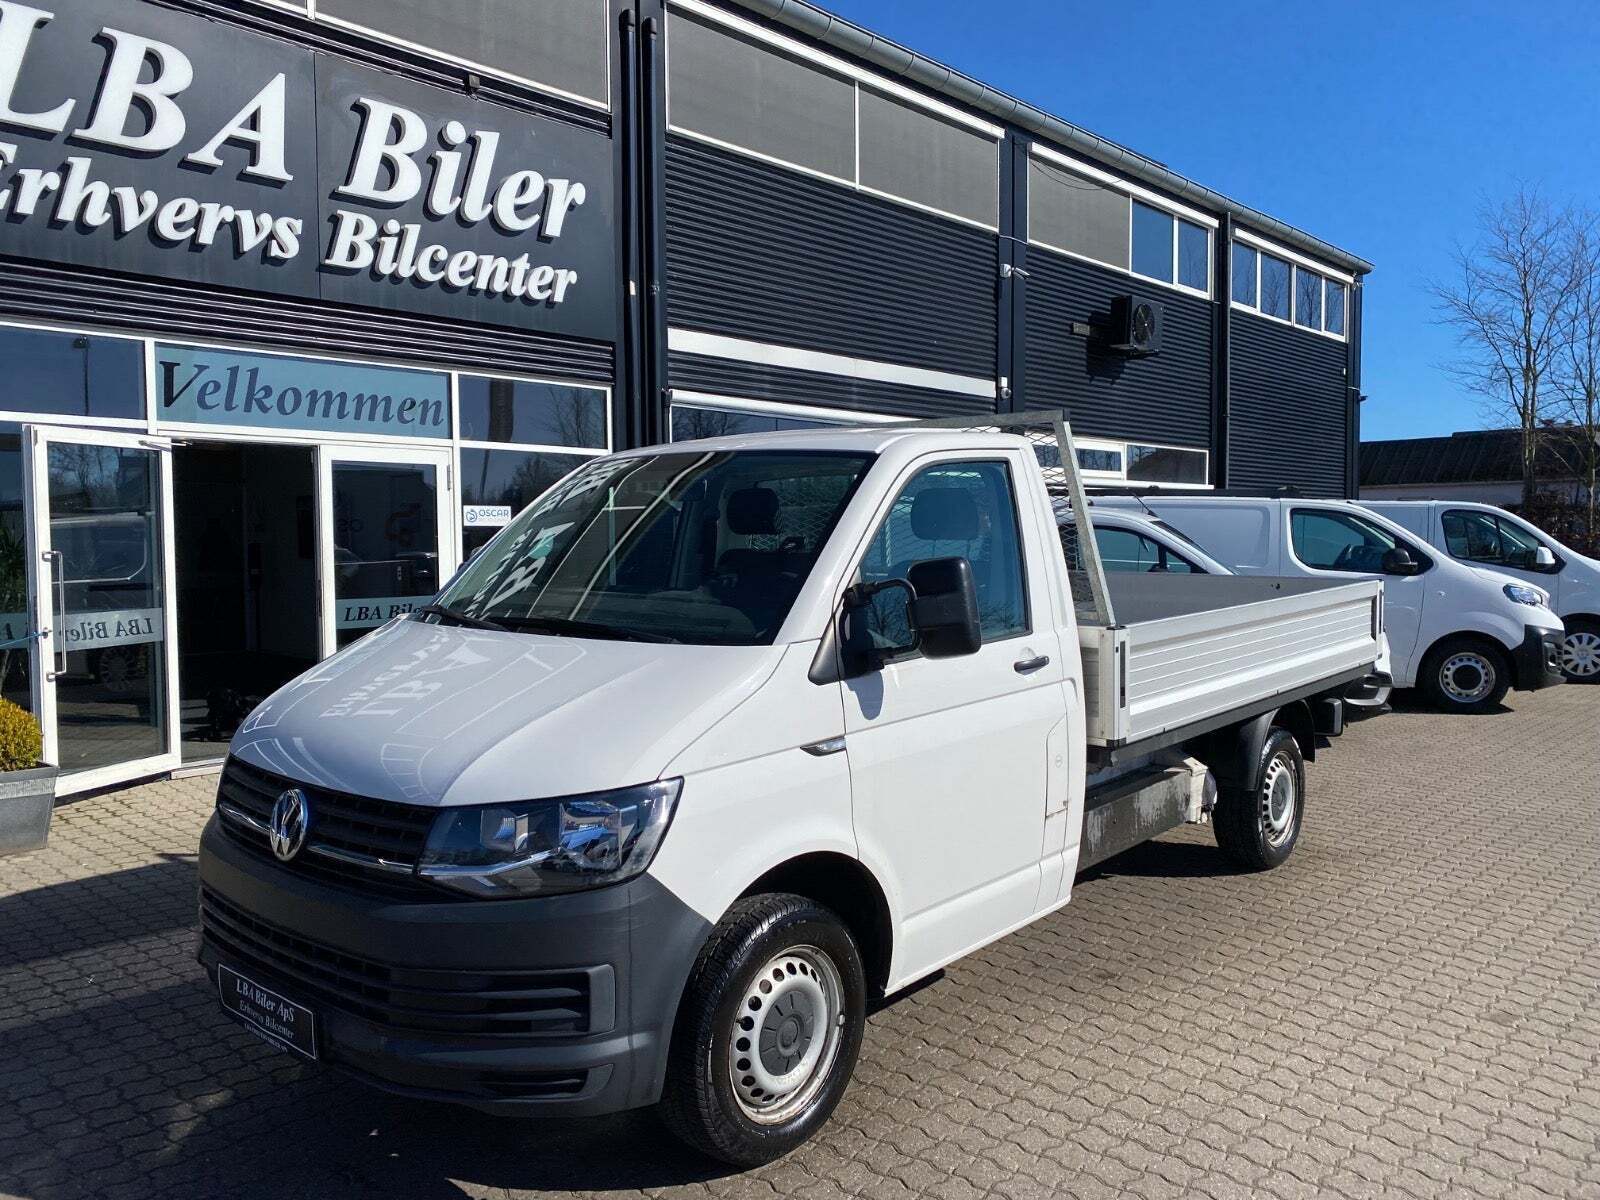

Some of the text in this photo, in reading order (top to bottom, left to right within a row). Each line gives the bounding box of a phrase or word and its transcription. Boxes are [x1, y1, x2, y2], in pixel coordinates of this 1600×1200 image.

[0, 1, 586, 238] LBA Biler
[324, 210, 577, 303] Bilcenter
[158, 360, 444, 427] Velkommen
[479, 509, 509, 517] OSCAR
[344, 606, 382, 621] LBA
[236, 979, 254, 1000] LBA
[255, 990, 276, 1011] Biler
